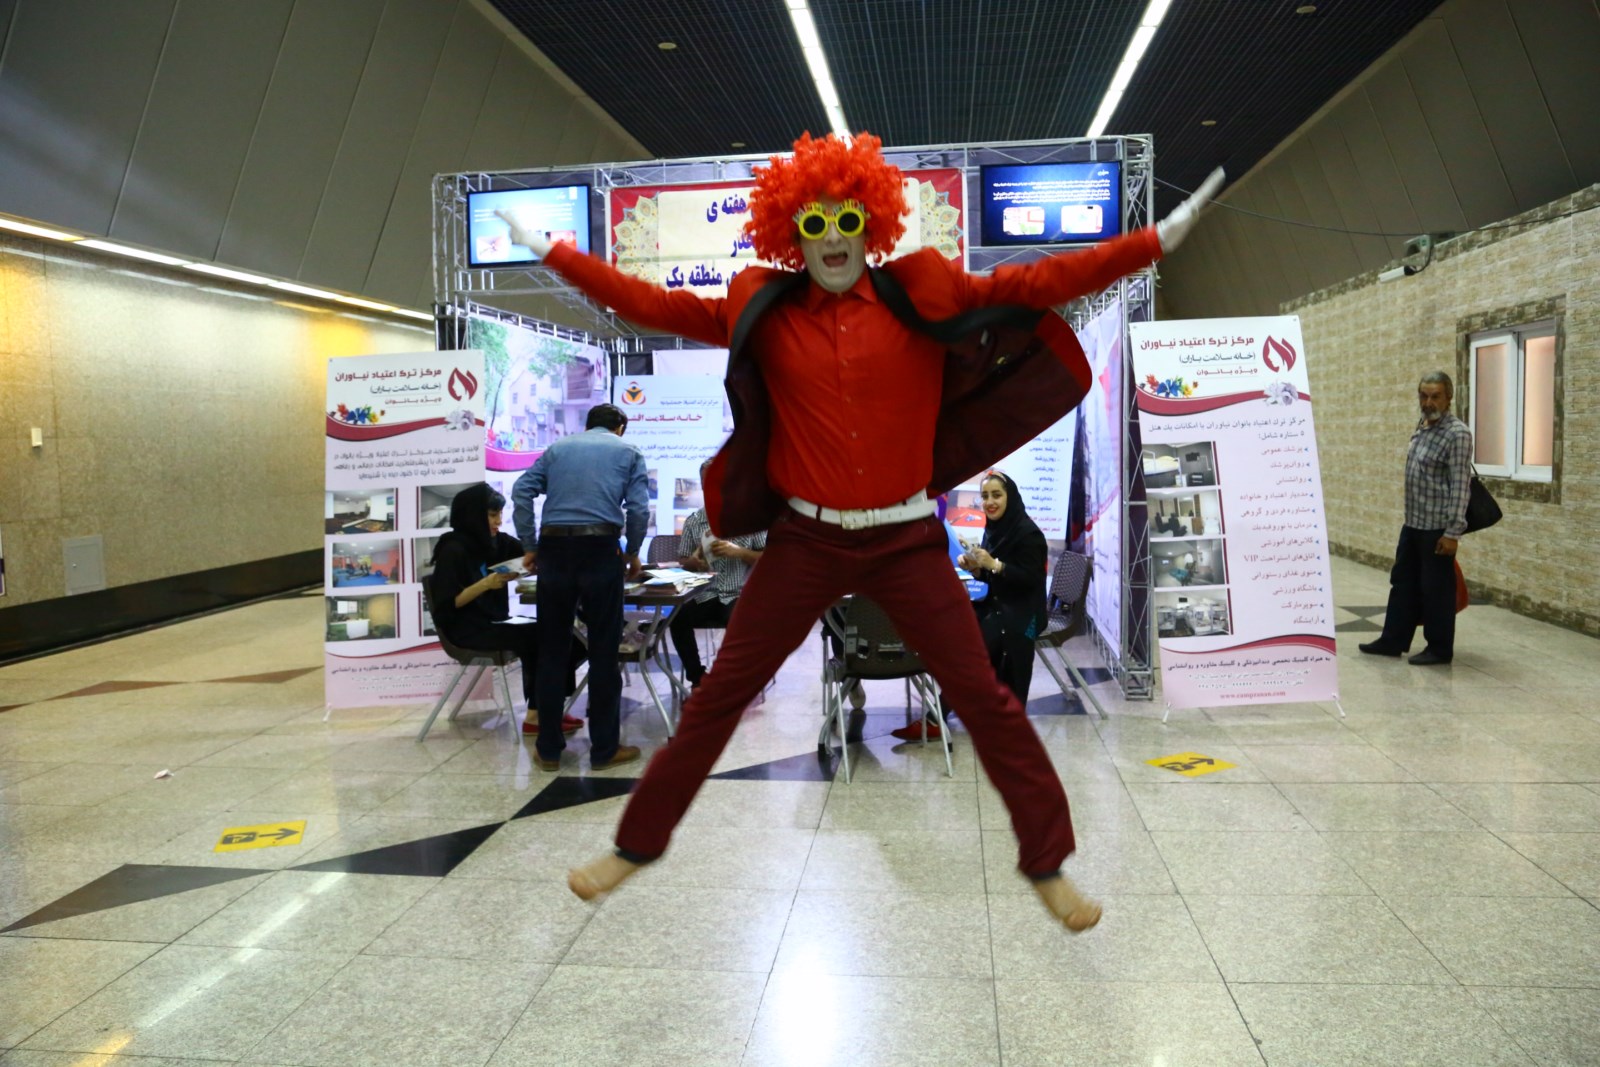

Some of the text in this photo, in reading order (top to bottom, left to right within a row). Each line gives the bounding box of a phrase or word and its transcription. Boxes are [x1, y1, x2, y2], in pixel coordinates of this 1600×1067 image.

[706, 194, 747, 223] هفته ی
[666, 266, 684, 288] یک
[688, 264, 722, 286] منطقه
[1140, 336, 1254, 350] مرکز ترک اعتیاد نیاوران
[1202, 353, 1232, 362] سلامت
[1234, 366, 1258, 374] ویژه
[335, 368, 442, 382] مرکز ترک اعتیاد نیاوران
[646, 414, 675, 422] سلامت
[1289, 417, 1305, 426] مرکز
[1280, 431, 1298, 439] ستاره
[1244, 554, 1258, 562] VIP
